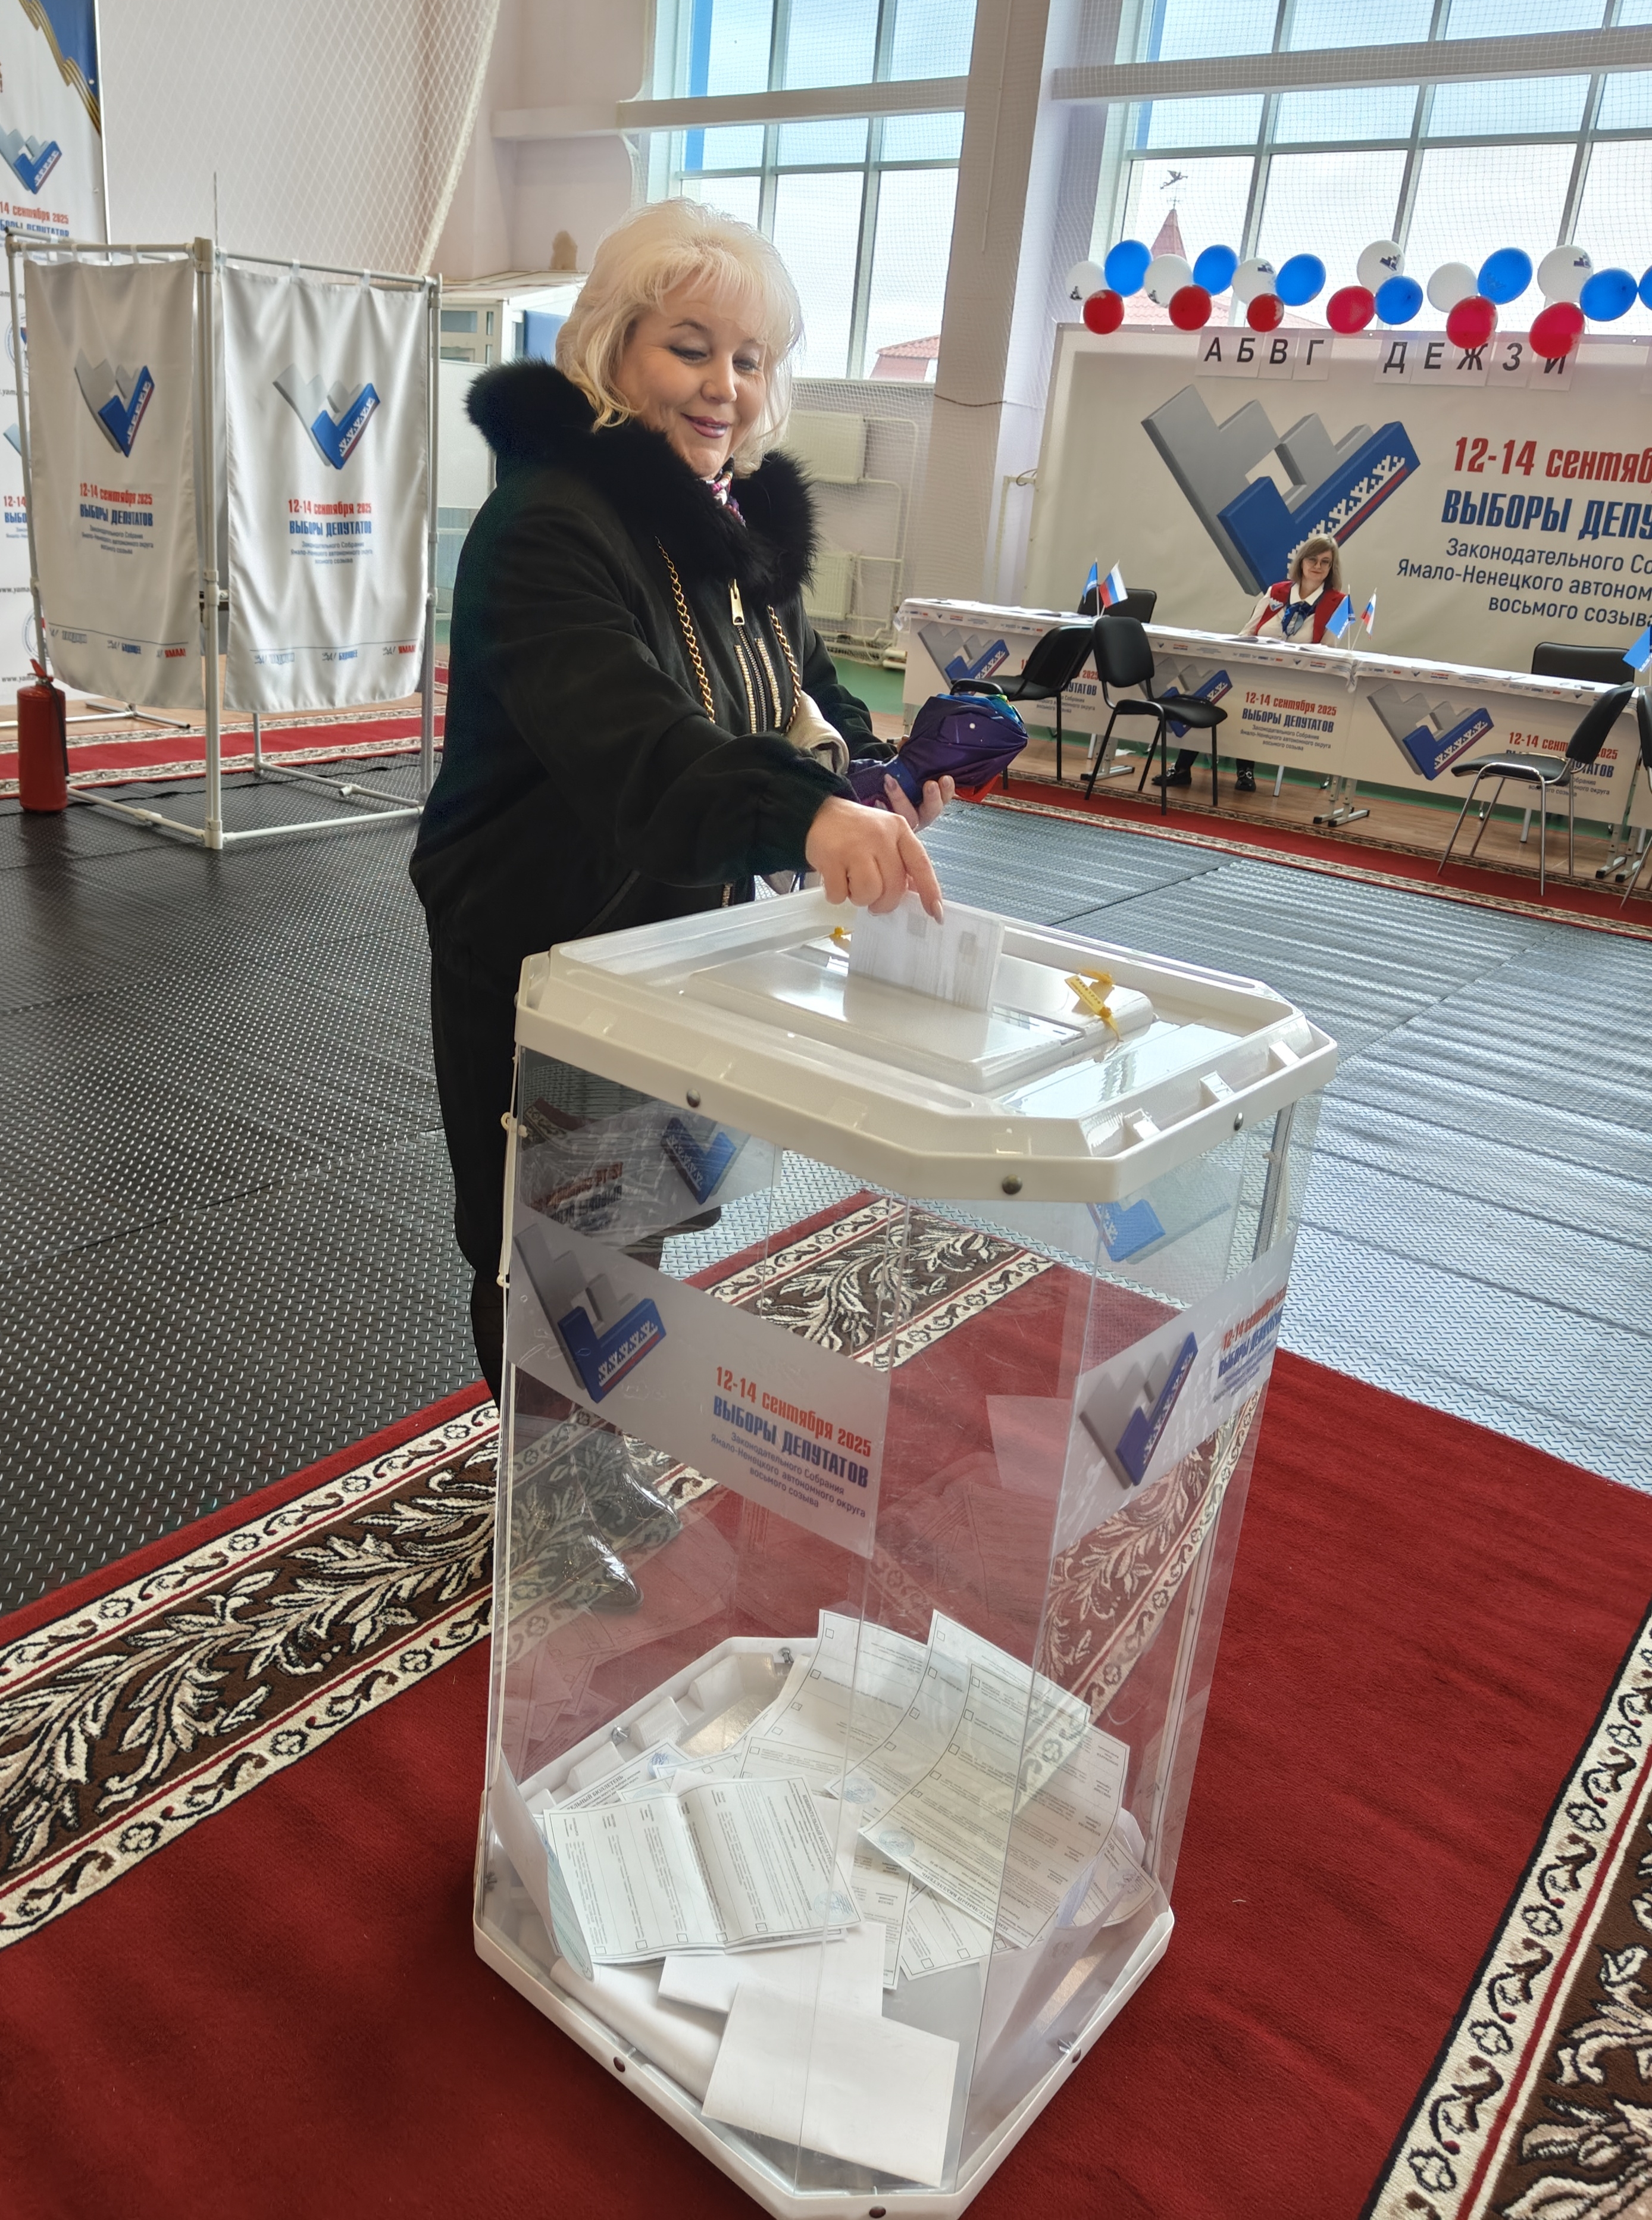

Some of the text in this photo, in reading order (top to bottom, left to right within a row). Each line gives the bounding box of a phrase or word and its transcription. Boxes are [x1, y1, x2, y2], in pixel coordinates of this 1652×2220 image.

[52, 213, 69, 224] 2025
[1203, 336, 1222, 362] А
[1236, 337, 1256, 363] Б
[1269, 338, 1288, 364] В
[1306, 339, 1324, 365] Г
[1382, 341, 1408, 374] Д
[1424, 342, 1445, 370] Е
[1456, 343, 1489, 371] Ж
[1503, 342, 1522, 371] З
[1454, 436, 1538, 476] 12-14
[80, 483, 153, 506] 12-14 сентября 2025
[5, 512, 27, 523] ВЫБО
[80, 504, 153, 526] ВЫБОРЫ ДЕПУТАТОВ
[289, 499, 371, 518] 12-14 сентября 2025
[1441, 489, 1573, 533] ВЫБОРЫ
[289, 520, 372, 537] ВЫБОРЫ ДЕПУТАТОВ
[1446, 537, 1624, 574] Законодательного
[1396, 559, 1563, 592] Ямало-Ненецкого
[1488, 597, 1578, 623] восьмого
[1065, 683, 1097, 696] УТАТОВ
[1246, 692, 1337, 716] 12-14 сентября 2025
[1242, 708, 1334, 733] ВЫБОРЫ ДЕПУТАТОВ
[1509, 732, 1539, 748] 12-14
[1542, 739, 1569, 752] сент
[716, 1367, 871, 1457] 12-14 сентября 2025
[714, 1395, 869, 1488] ВЫБОРЫ ДЕПУТАТОВ
[711, 1434, 866, 1518] Ямало-Ненецкого автономного округа
[731, 1432, 844, 1495] Законодательного Собрания
[750, 1468, 819, 1508] восьмого созыва
